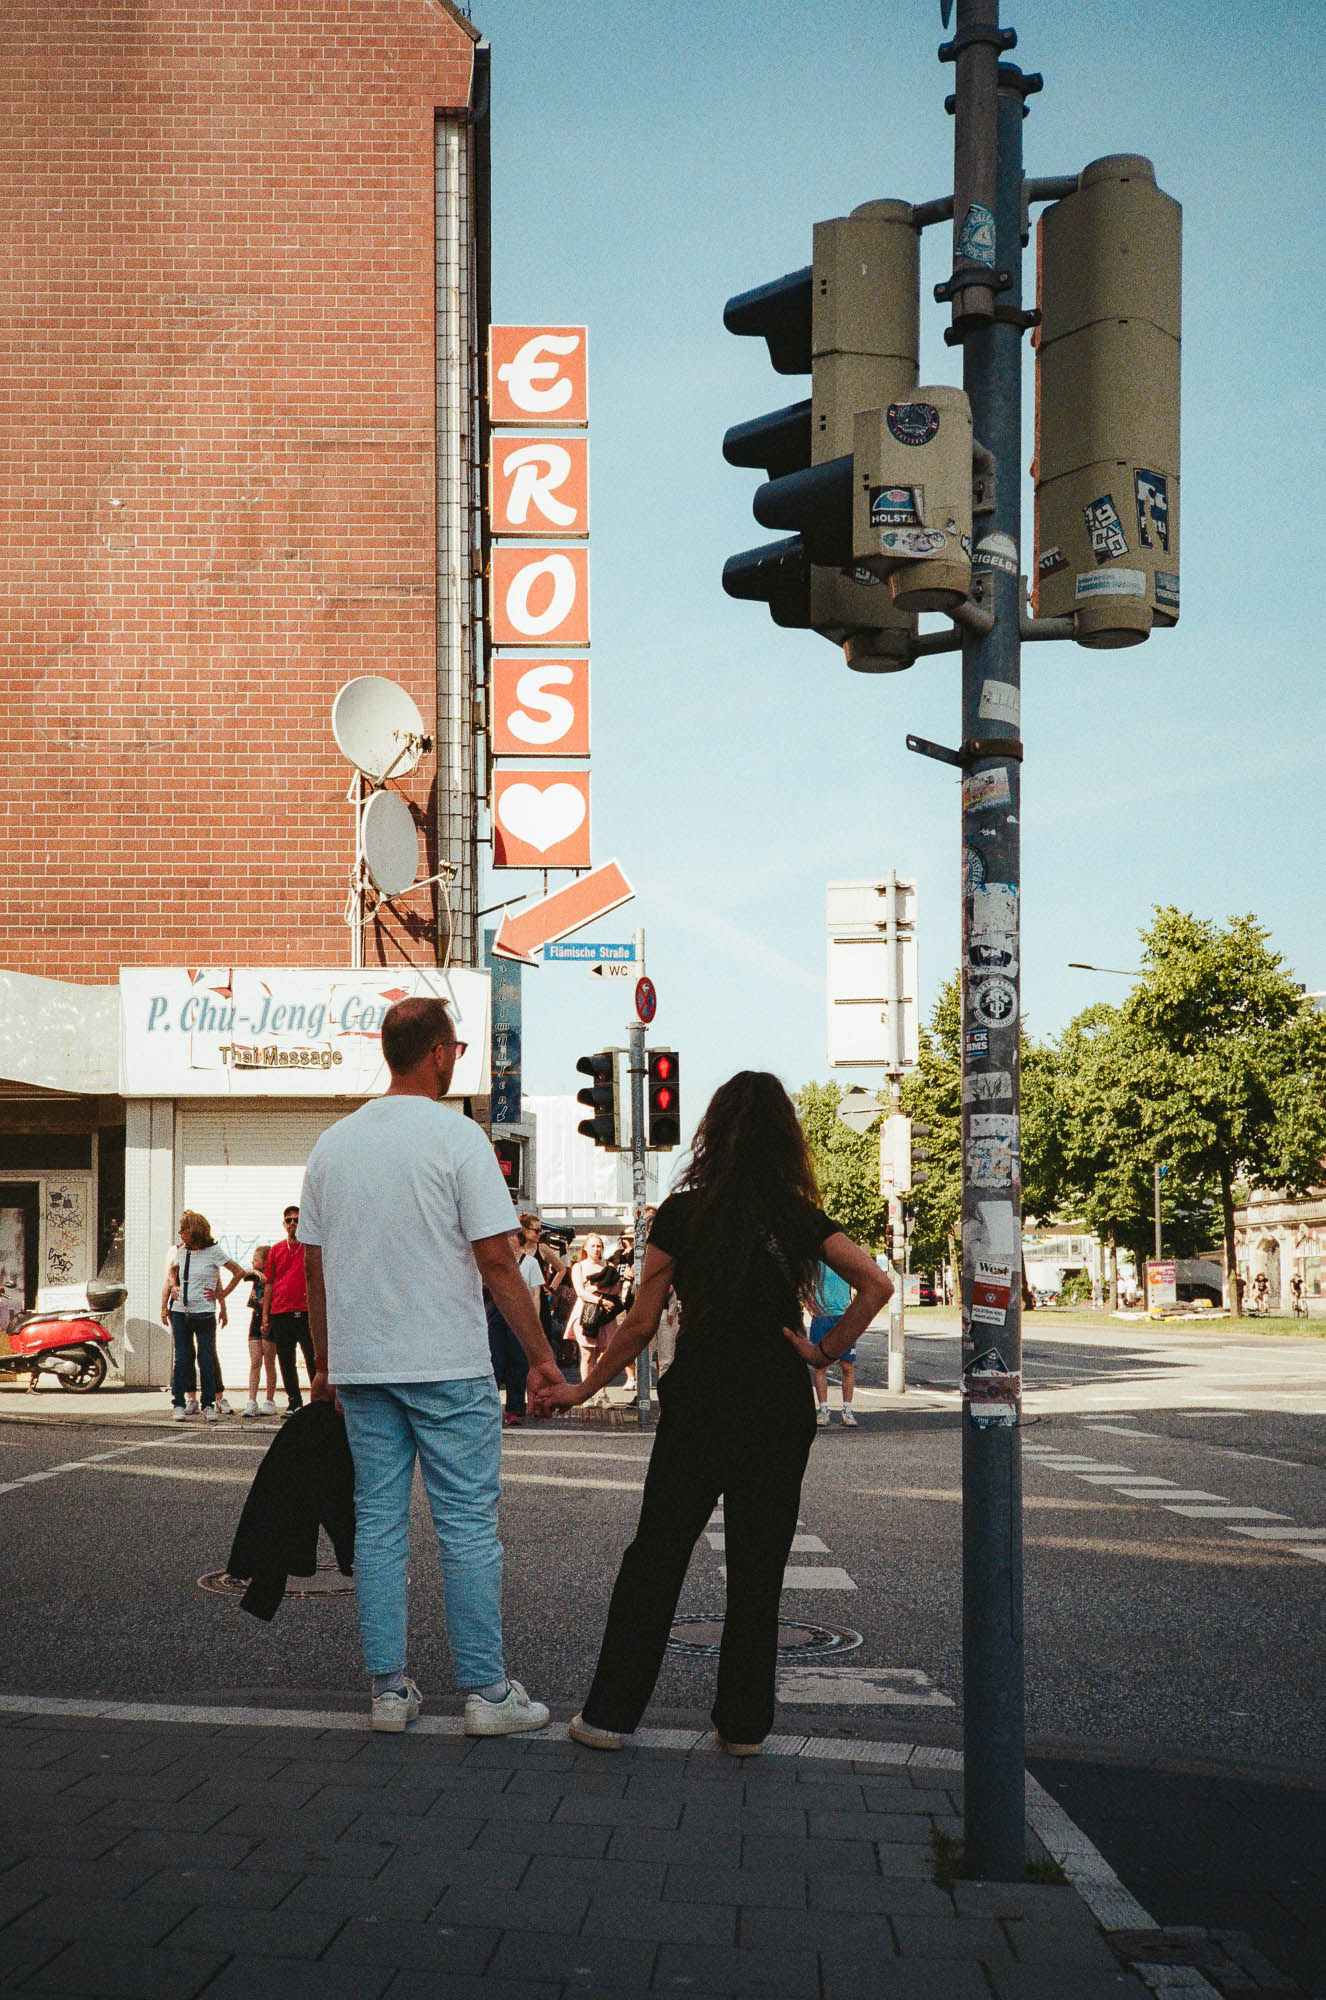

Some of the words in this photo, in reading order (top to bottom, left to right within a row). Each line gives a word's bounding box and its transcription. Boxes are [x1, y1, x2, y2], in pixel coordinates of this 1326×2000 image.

[497, 334, 579, 744] EROS
[550, 945, 596, 958] Flämische
[599, 946, 630, 958] Straße
[609, 965, 628, 976] WC
[147, 996, 170, 1032] P.
[180, 995, 328, 1039] Chu-Jeng
[219, 1046, 259, 1066] Thai
[263, 1045, 343, 1069] Massage
[979, 1261, 1009, 1276] West
